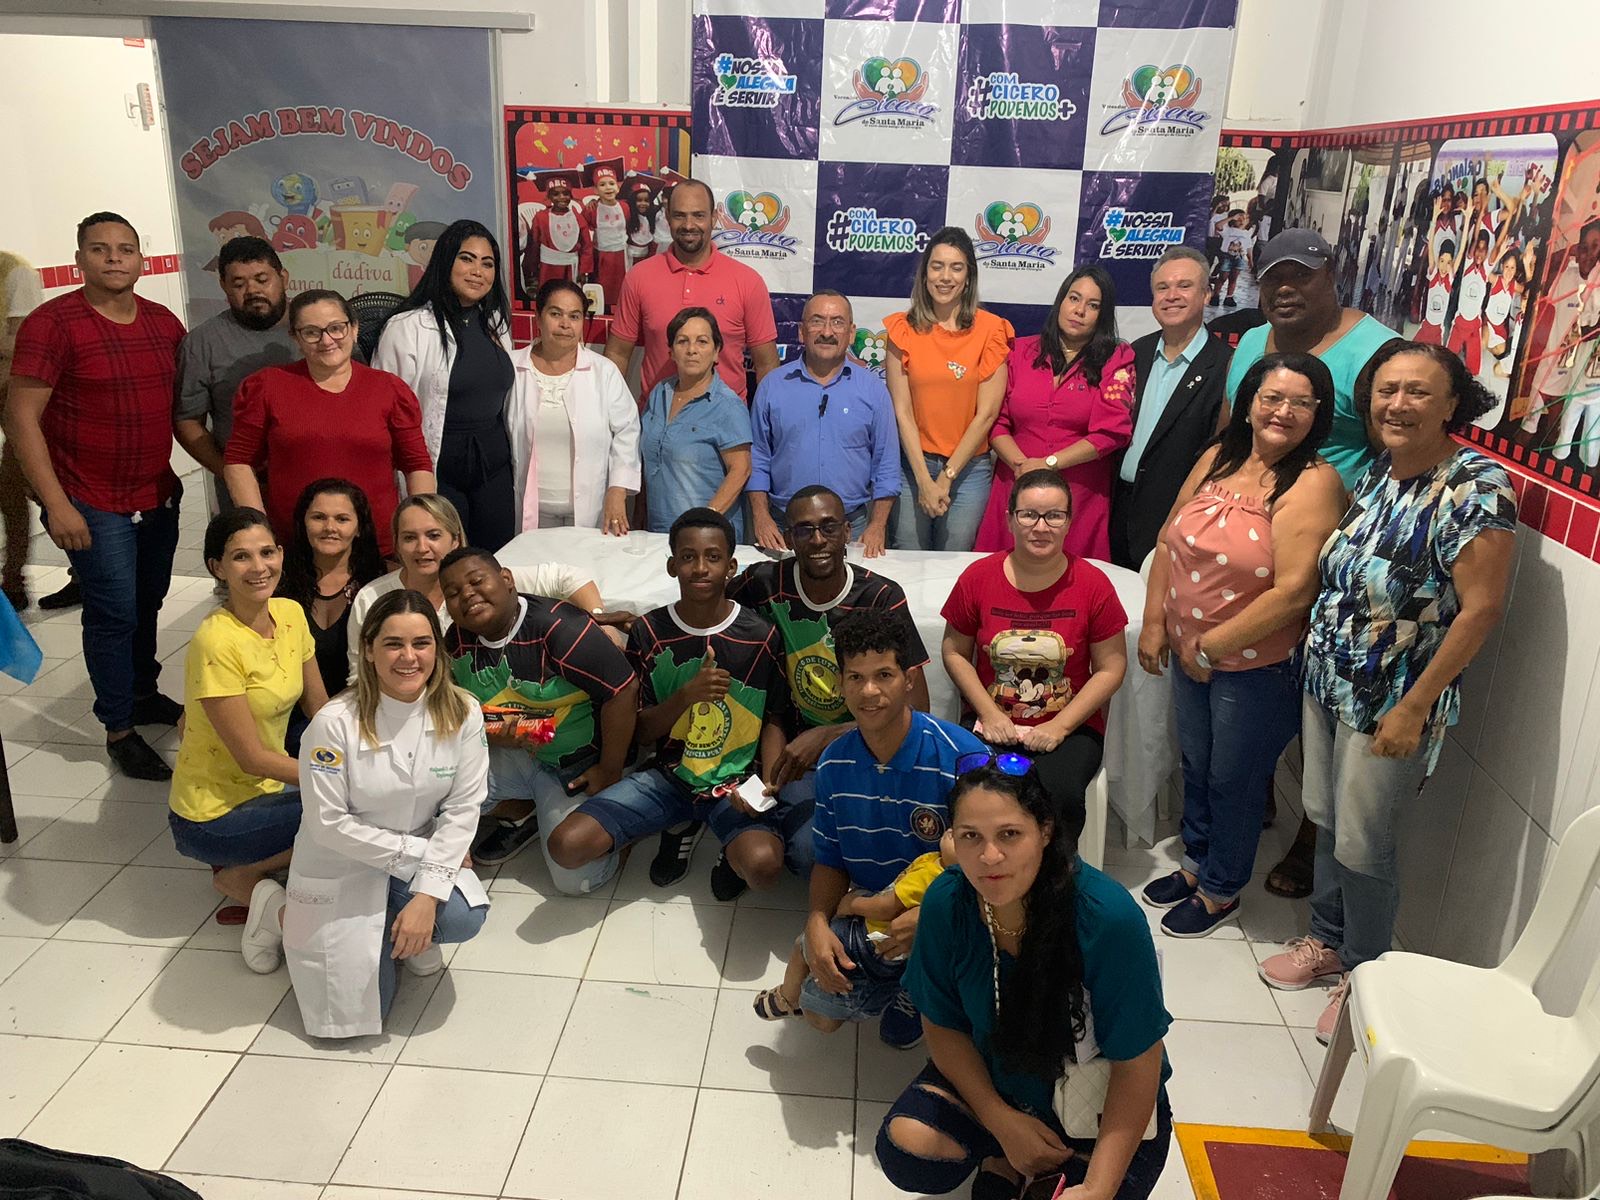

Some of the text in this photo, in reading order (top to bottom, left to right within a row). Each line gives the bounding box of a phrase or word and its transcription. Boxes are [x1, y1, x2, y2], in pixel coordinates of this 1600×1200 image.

[990, 74, 1017, 84] COM
[715, 88, 776, 104] É SERVIR
[991, 85, 1058, 101] CICERO
[869, 117, 896, 126] Santa
[897, 118, 925, 127] Maria
[1167, 126, 1195, 134] Maria
[181, 107, 472, 190] SEJAM BEM VINDOS
[548, 181, 567, 189] ABC
[849, 209, 875, 219] COM
[1106, 210, 1171, 228] #NOSSA
[851, 219, 914, 235] CICERO
[1125, 229, 1183, 242] ALEGRIA
[734, 248, 760, 256] Santa
[761, 249, 787, 258] Maria
[1103, 240, 1165, 256] É SERVIR
[332, 260, 393, 281] dádiva
[990, 259, 1017, 267] Santa
[1018, 261, 1045, 269] Maria
